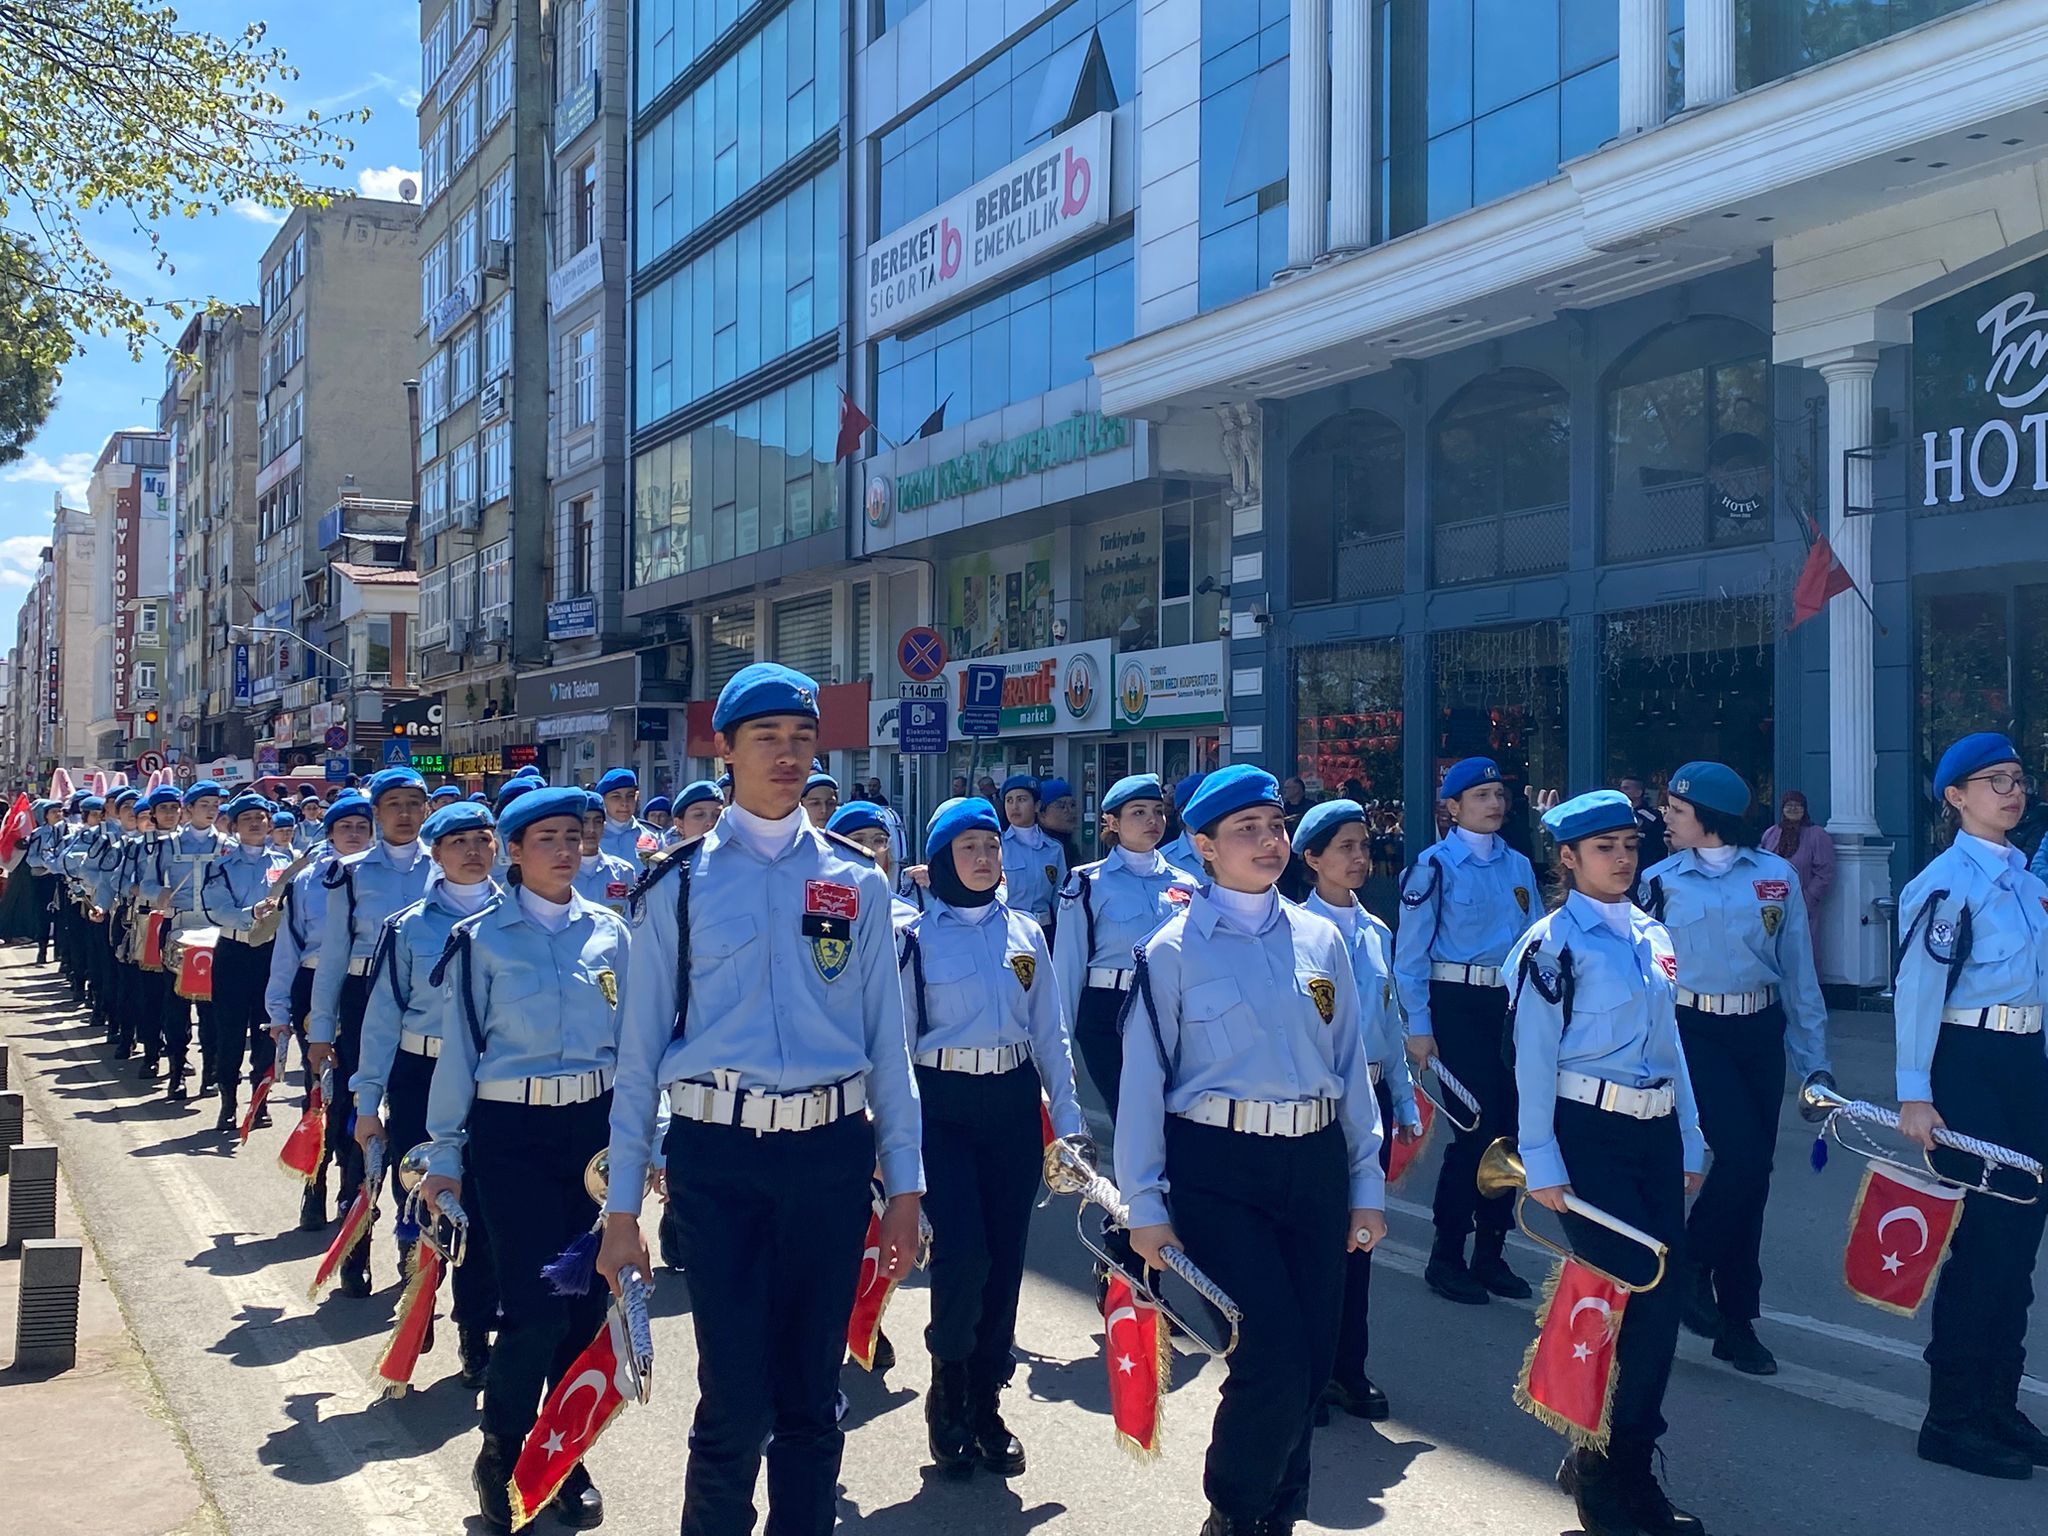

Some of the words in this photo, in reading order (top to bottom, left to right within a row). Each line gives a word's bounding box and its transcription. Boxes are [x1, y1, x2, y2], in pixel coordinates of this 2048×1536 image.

[975, 153, 1061, 232] BEREKET
[974, 196, 1059, 266] EMEKLİLİK
[870, 223, 938, 288] BEREKET
[870, 265, 937, 317] SİGORTA
[144, 477, 165, 497] My
[1721, 496, 1760, 512] HOTEL
[117, 518, 128, 545] MY
[116, 555, 128, 628] HOUSE
[115, 637, 126, 710] HOTEL
[975, 672, 996, 702] P
[558, 683, 572, 700] Türk
[573, 680, 600, 698] Telekom
[910, 685, 929, 698] 140
[1020, 710, 1048, 724] market
[412, 756, 443, 765] PIDE
